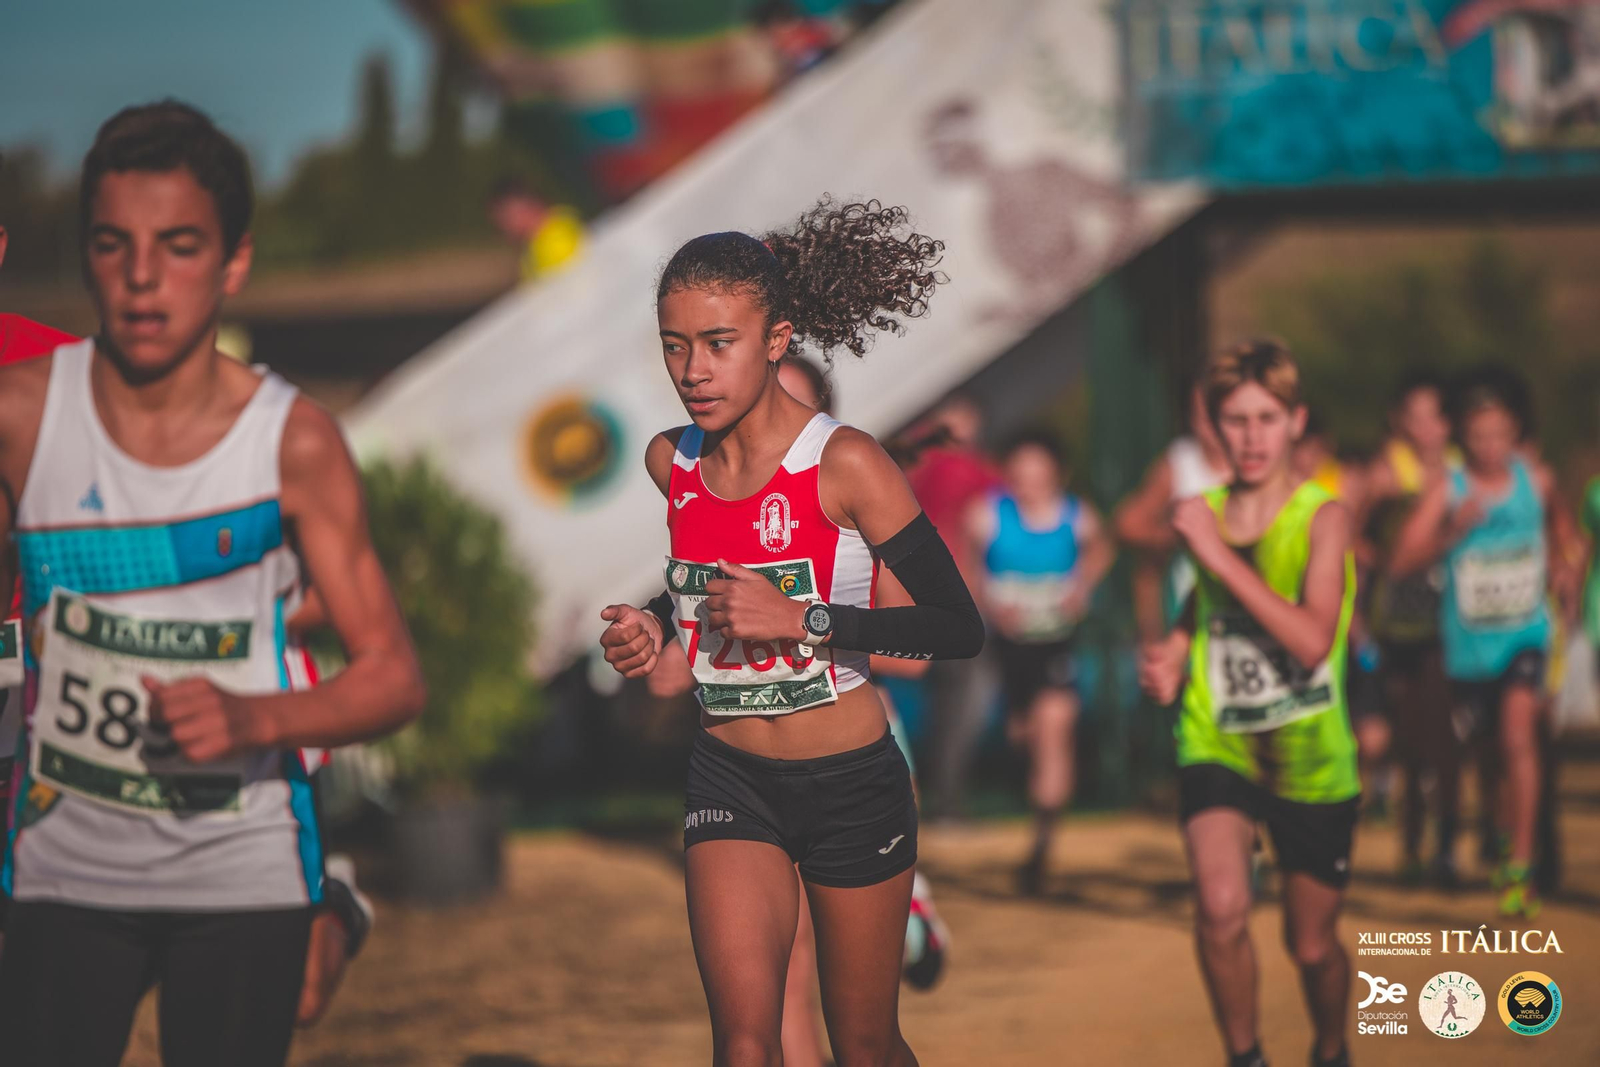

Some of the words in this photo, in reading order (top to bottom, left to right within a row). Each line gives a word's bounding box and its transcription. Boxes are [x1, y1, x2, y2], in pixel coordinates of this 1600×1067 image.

[752, 521, 760, 530] 19
[791, 520, 799, 529] 67
[763, 542, 789, 553] HUELVA
[684, 808, 734, 830] URTIUS
